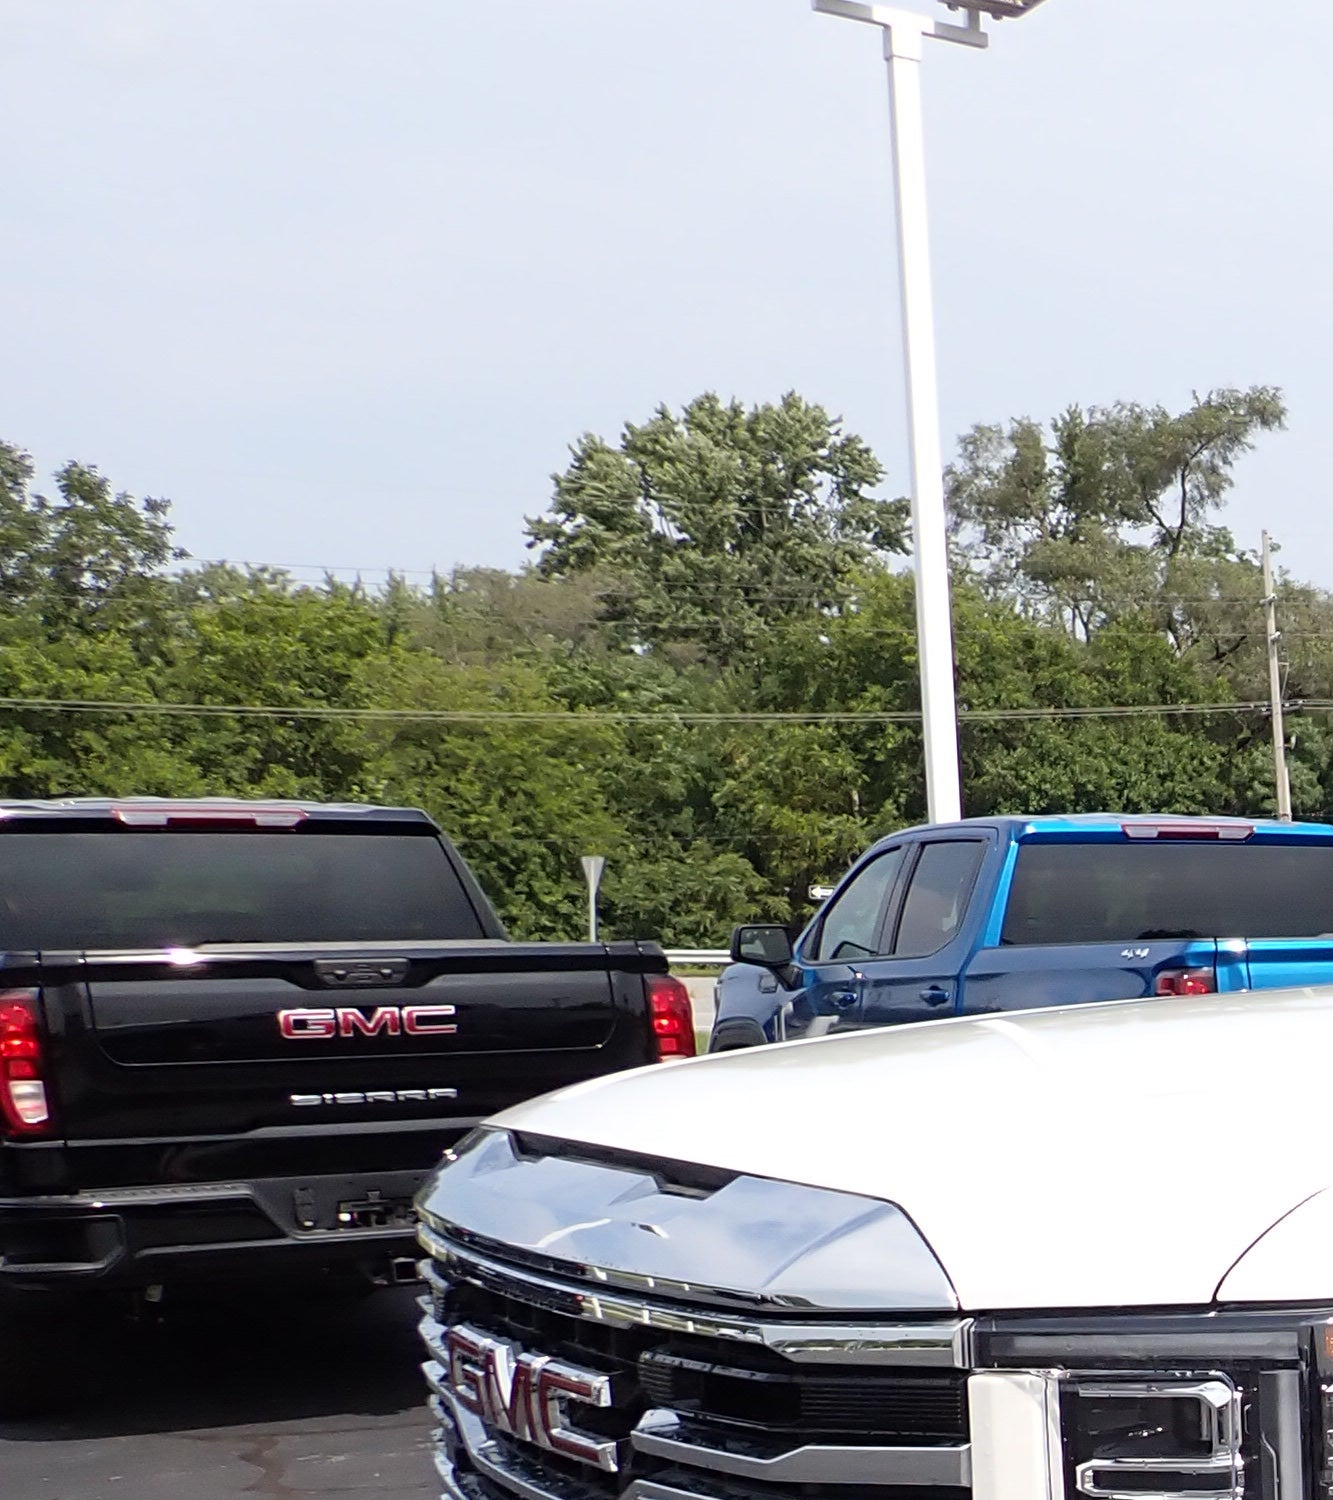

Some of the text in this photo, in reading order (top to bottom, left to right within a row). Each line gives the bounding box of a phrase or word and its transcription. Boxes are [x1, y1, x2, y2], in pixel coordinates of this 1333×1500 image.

[278, 1005, 458, 1040] GMC
[290, 1088, 458, 1106] SIERRA
[447, 1325, 620, 1473] GMC
